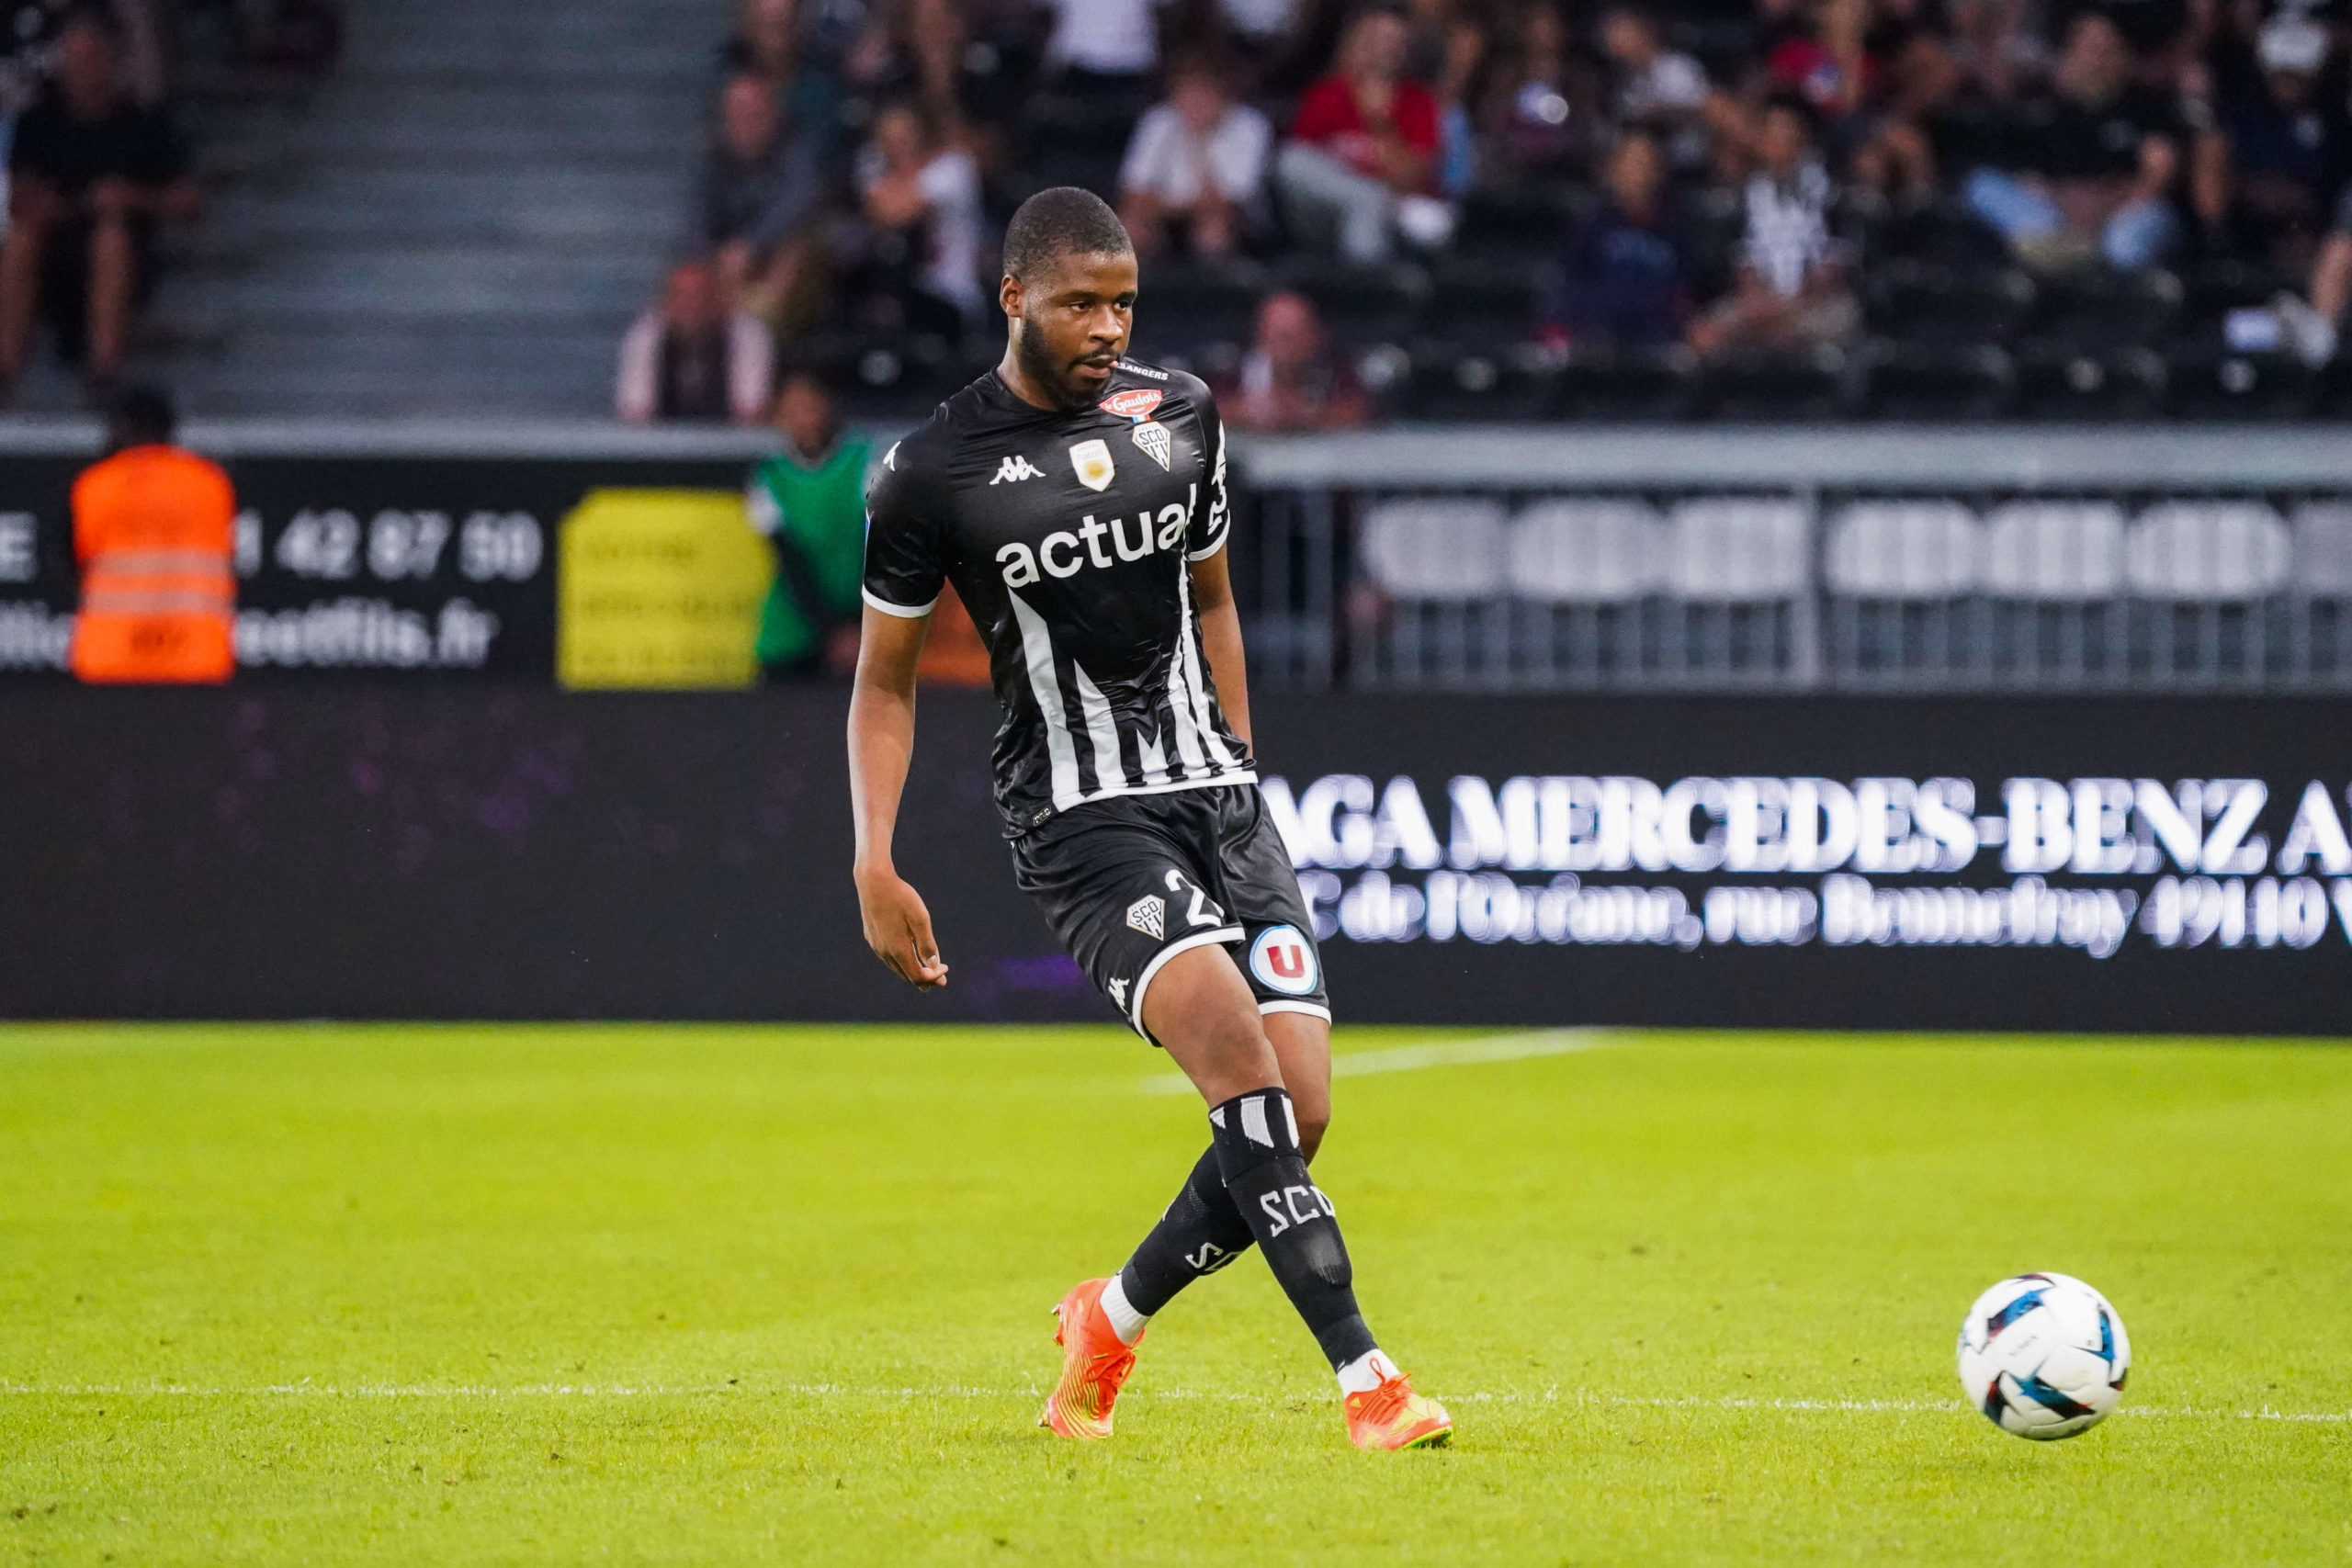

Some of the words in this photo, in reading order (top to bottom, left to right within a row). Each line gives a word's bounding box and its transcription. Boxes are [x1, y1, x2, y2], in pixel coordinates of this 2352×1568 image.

[1113, 392, 1161, 412] Gaulois
[1138, 428, 1165, 446] SCO
[995, 483, 1197, 588] actual
[1448, 775, 2269, 874] MERCEDES-BENZ
[2275, 779, 2352, 876] A
[1132, 901, 1159, 923] SCO
[1165, 869, 1225, 927] 2
[1266, 944, 1306, 978] U
